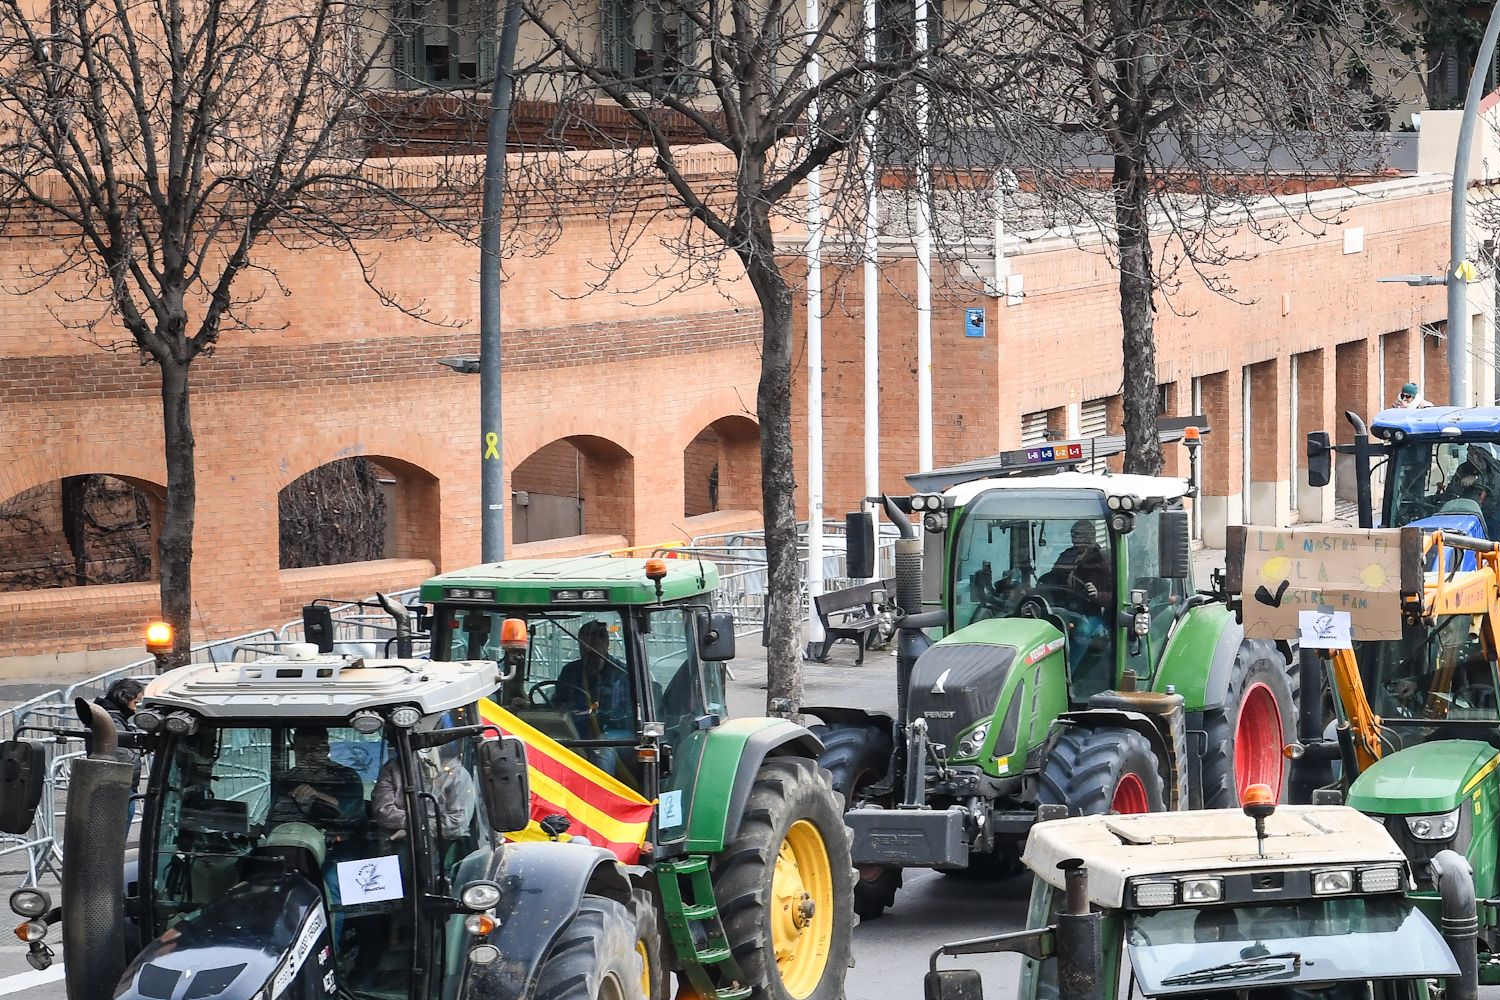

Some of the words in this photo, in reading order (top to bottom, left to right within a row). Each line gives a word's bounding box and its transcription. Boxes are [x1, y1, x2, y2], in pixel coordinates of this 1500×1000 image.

[1258, 530, 1286, 552] LA
[1296, 560, 1329, 583] LA
[923, 711, 957, 719] FENDT
